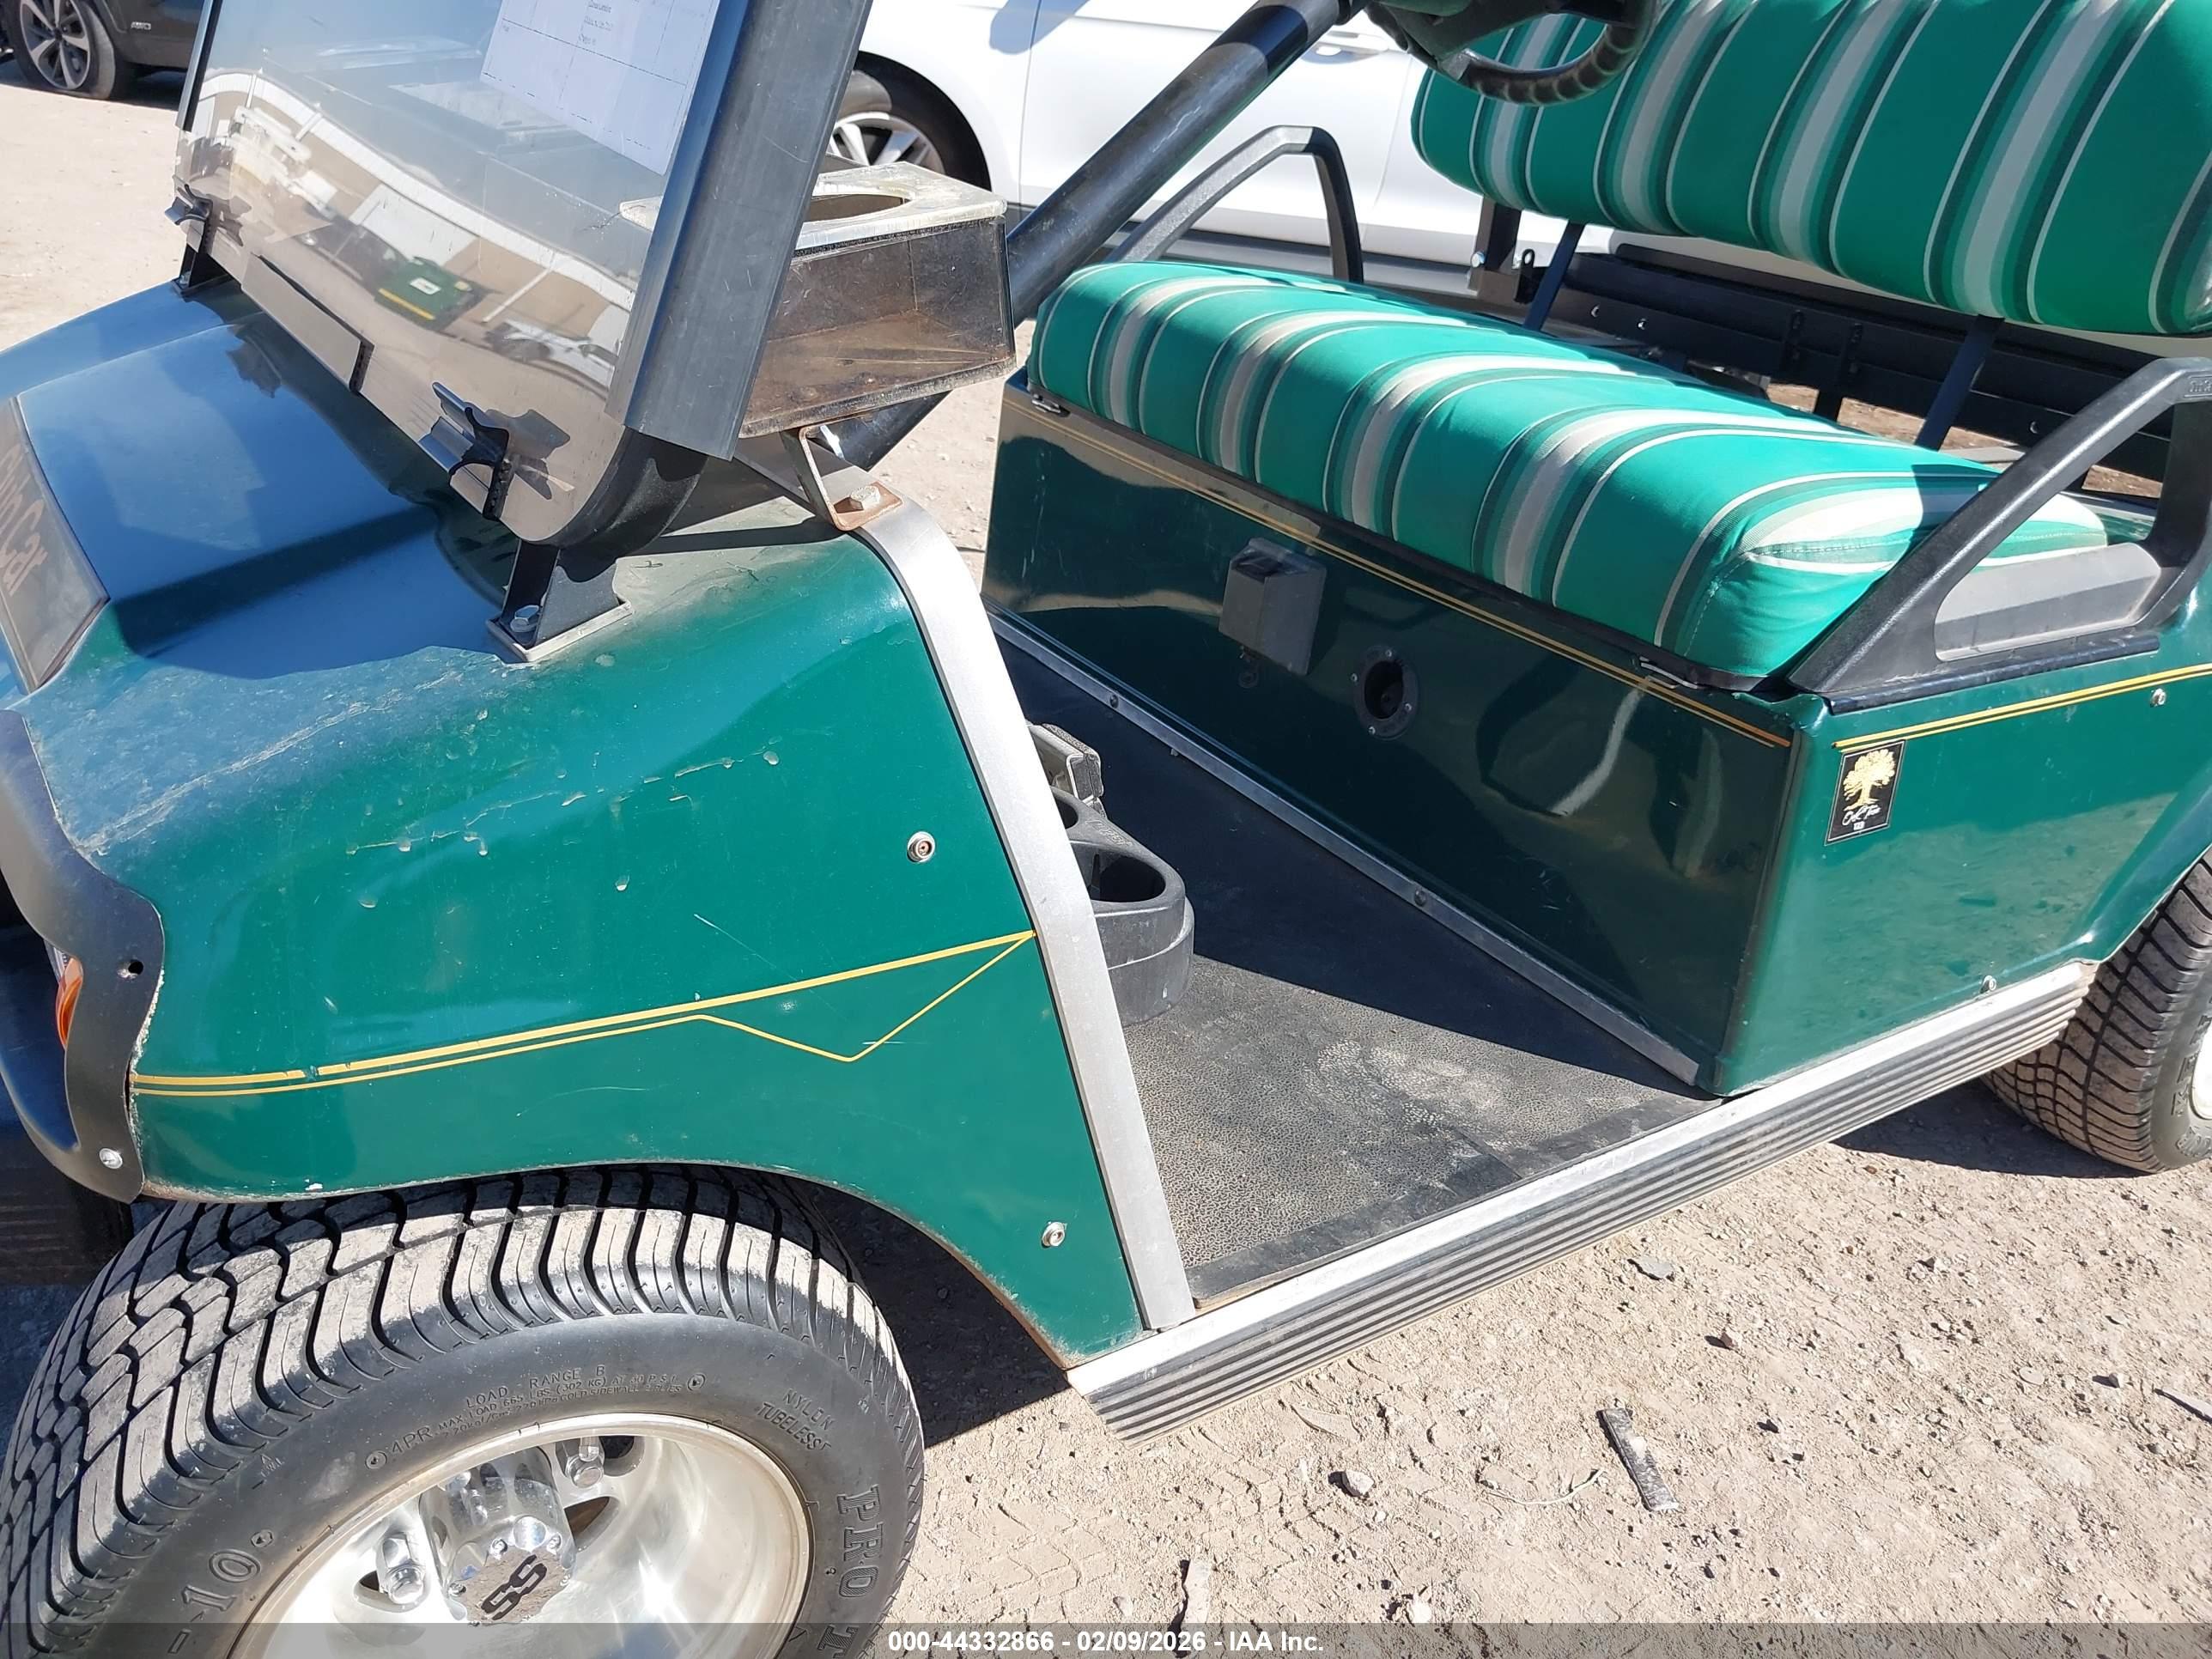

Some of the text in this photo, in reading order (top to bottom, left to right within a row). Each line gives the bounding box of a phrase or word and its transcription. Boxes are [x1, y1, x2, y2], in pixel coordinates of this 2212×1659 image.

[466, 1364, 606, 1409] LOAD RANGE B
[782, 1388, 837, 1431] NYLON
[391, 1425, 434, 1455] 4PR
[757, 1401, 823, 1451] TUBELESS
[836, 1483, 885, 1599] PRO
[480, 1553, 548, 1621] SS
